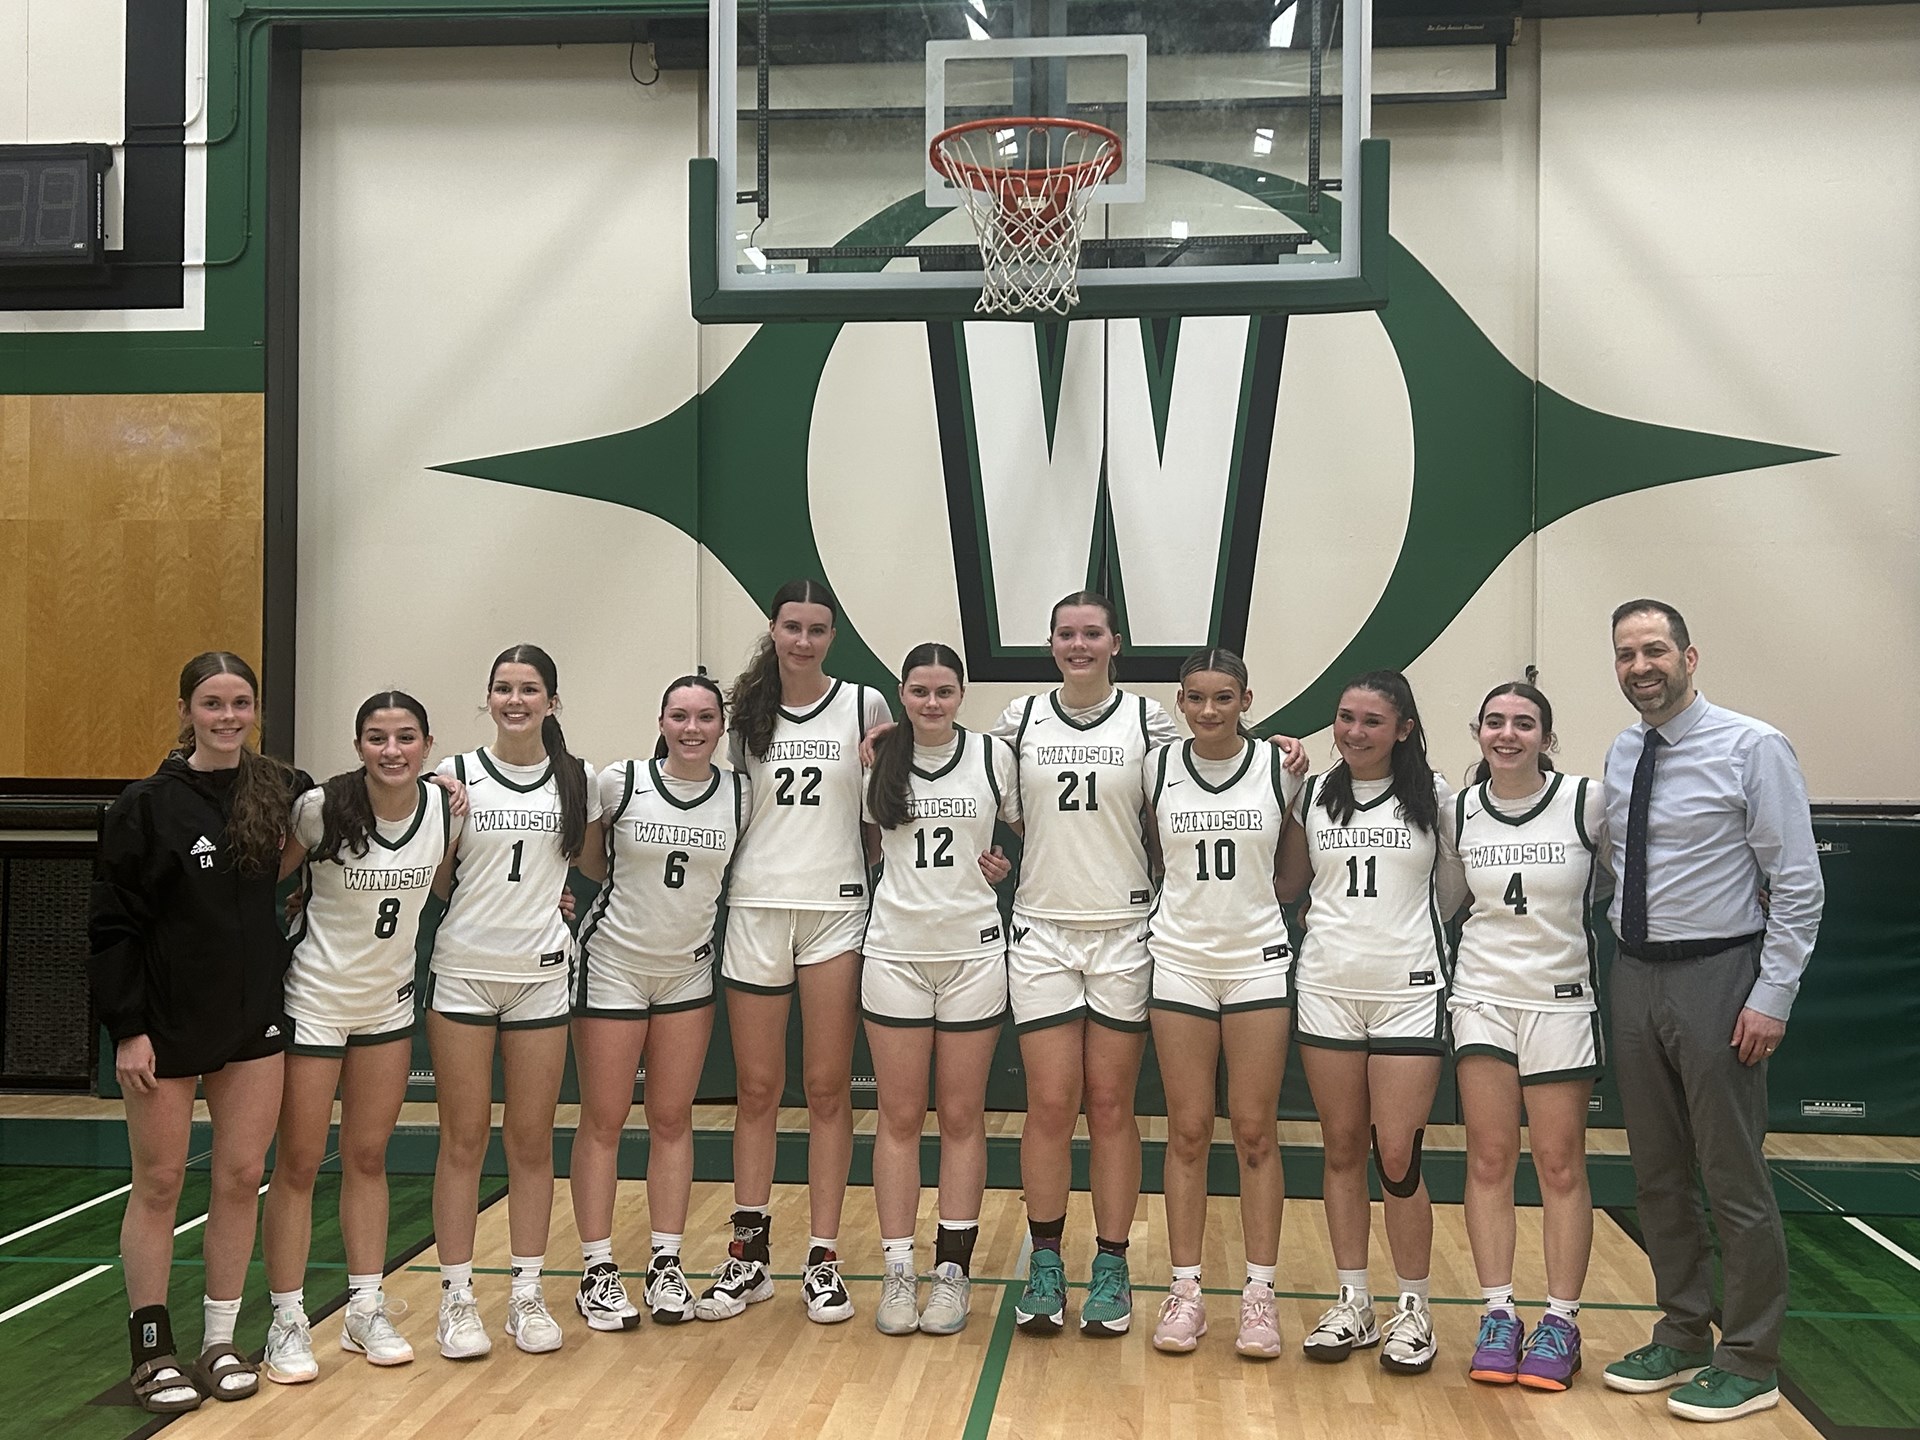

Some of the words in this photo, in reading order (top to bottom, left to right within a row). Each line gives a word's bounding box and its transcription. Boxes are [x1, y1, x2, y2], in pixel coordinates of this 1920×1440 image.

[927, 314, 1289, 682] W
[1037, 746, 1124, 766] WINDSOR
[775, 767, 822, 806] 22
[1057, 771, 1099, 811] 21
[634, 822, 726, 850] WINDSOR
[1170, 810, 1262, 833] WINDSOR
[1317, 827, 1411, 850] WINDSOR
[199, 855, 213, 868] EA
[507, 840, 523, 882] 1
[914, 827, 954, 868] 12
[1195, 838, 1236, 881] 10
[1470, 842, 1565, 868] WINDSOR
[344, 866, 433, 891] WINDSOR
[663, 851, 689, 889] 6
[1346, 856, 1377, 897] 11
[1503, 872, 1527, 915] 4
[375, 898, 401, 939] 8
